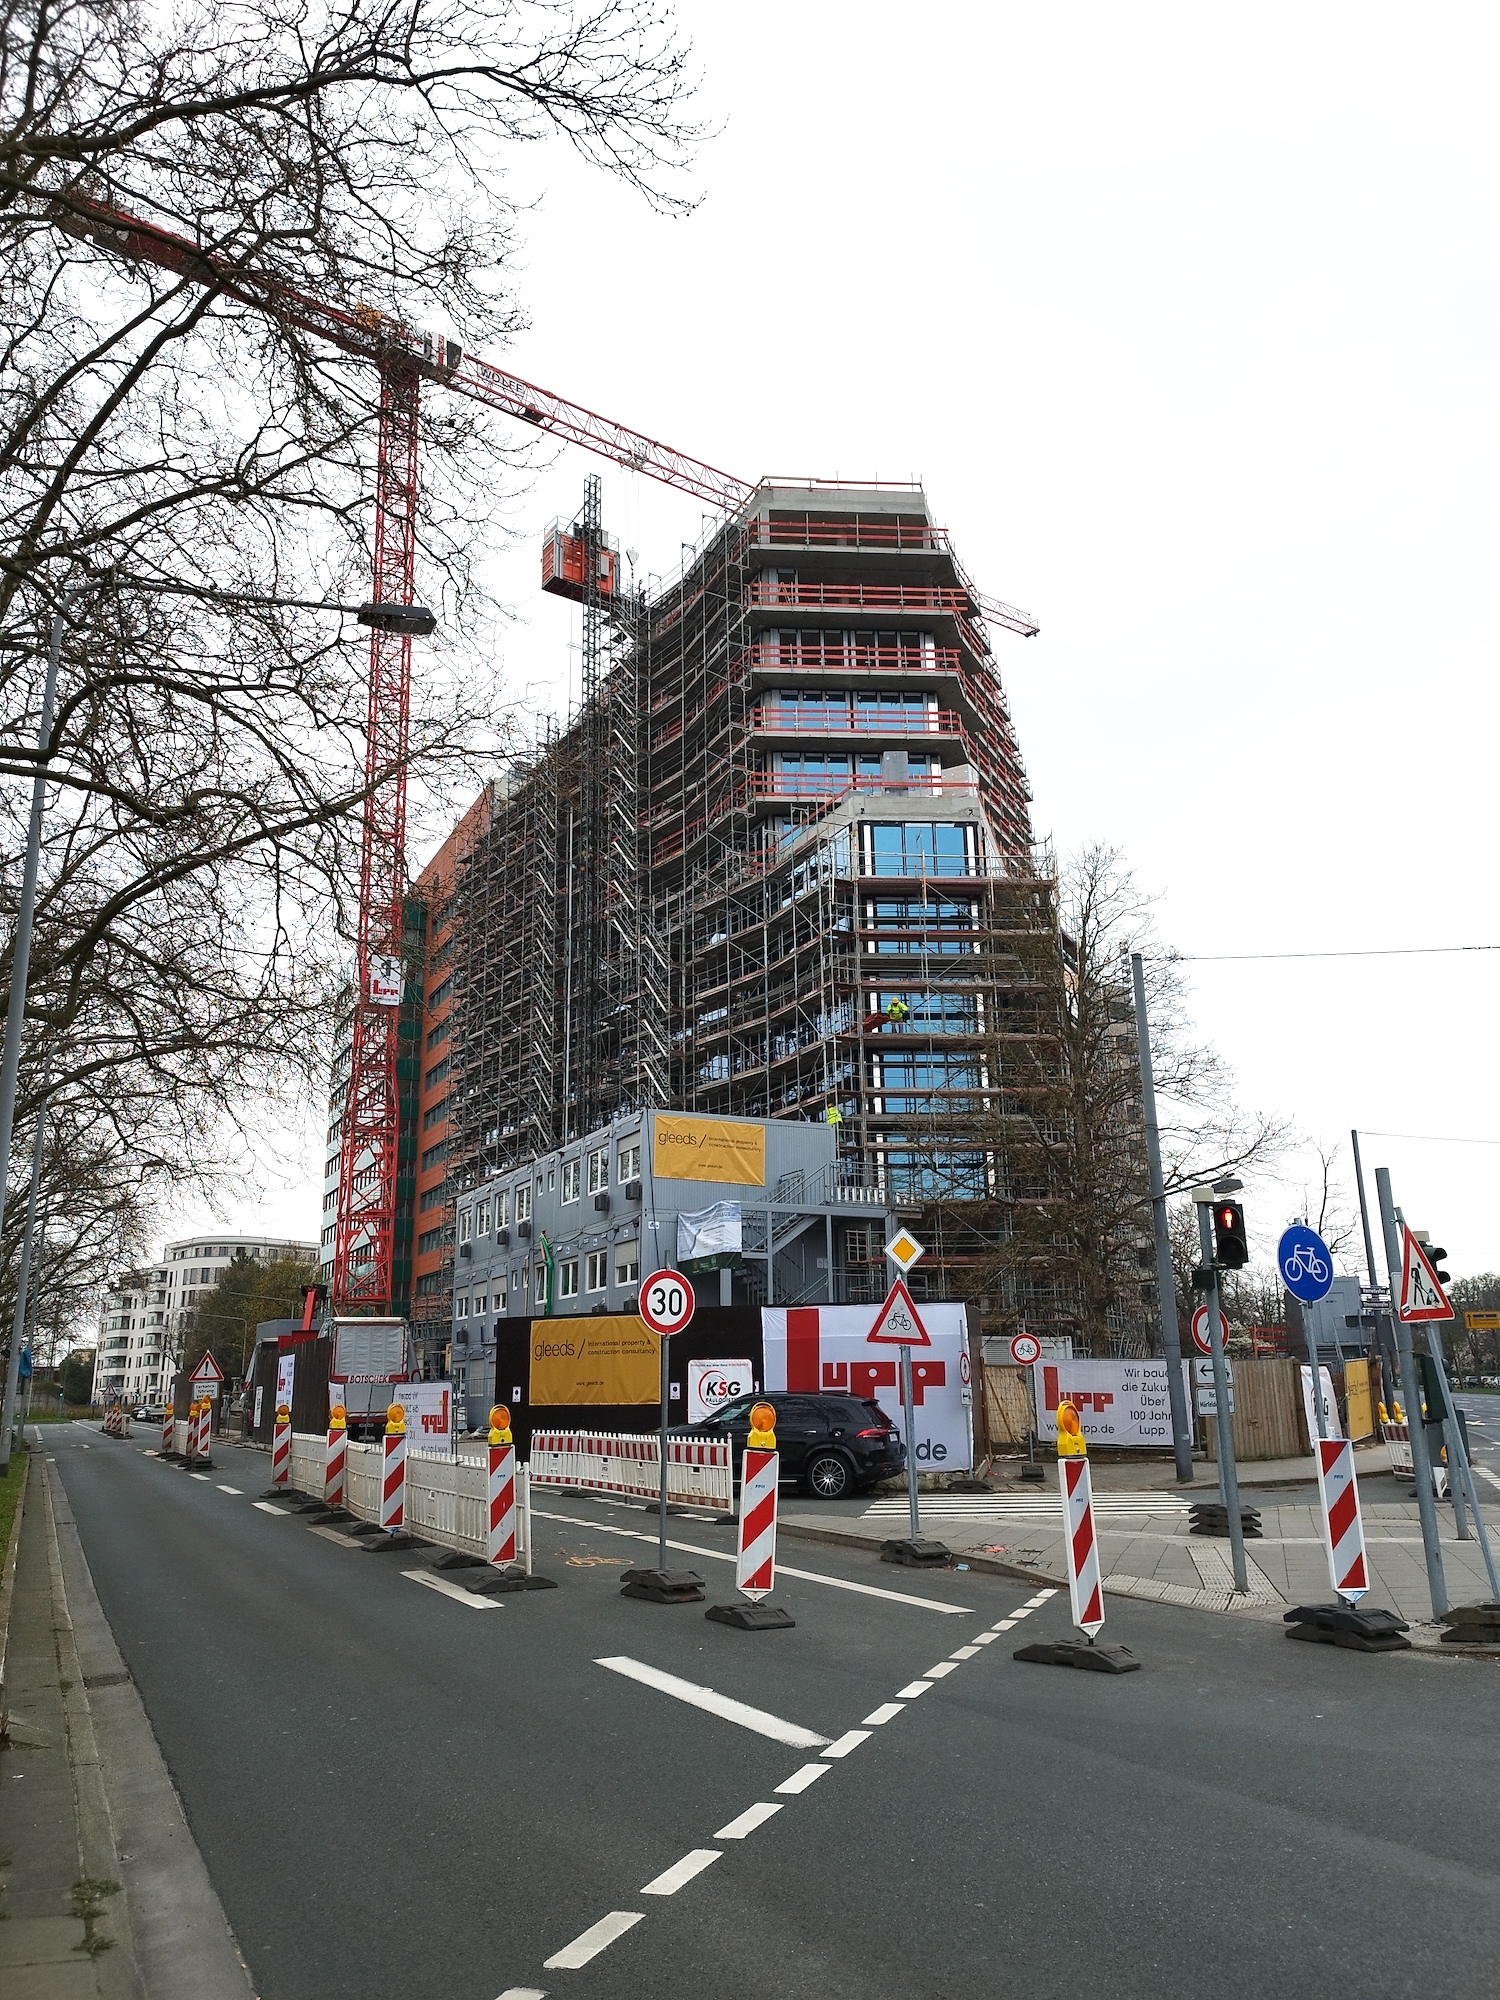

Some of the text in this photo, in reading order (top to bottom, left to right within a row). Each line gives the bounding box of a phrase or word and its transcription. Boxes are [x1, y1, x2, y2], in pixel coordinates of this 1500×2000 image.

[658, 1131, 697, 1145] gleeds
[652, 1287, 683, 1317] 30
[587, 1339, 620, 1347] International
[621, 1339, 645, 1347] property
[534, 1339, 575, 1361] gleeds
[621, 1348, 656, 1356] consultancy
[1124, 1368, 1141, 1378] Wir
[706, 1381, 741, 1397] KSG
[1121, 1382, 1139, 1392] die
[1140, 1394, 1165, 1406] Über
[1129, 1410, 1172, 1421] 100 Jahr
[1139, 1425, 1168, 1436] Lupp.
